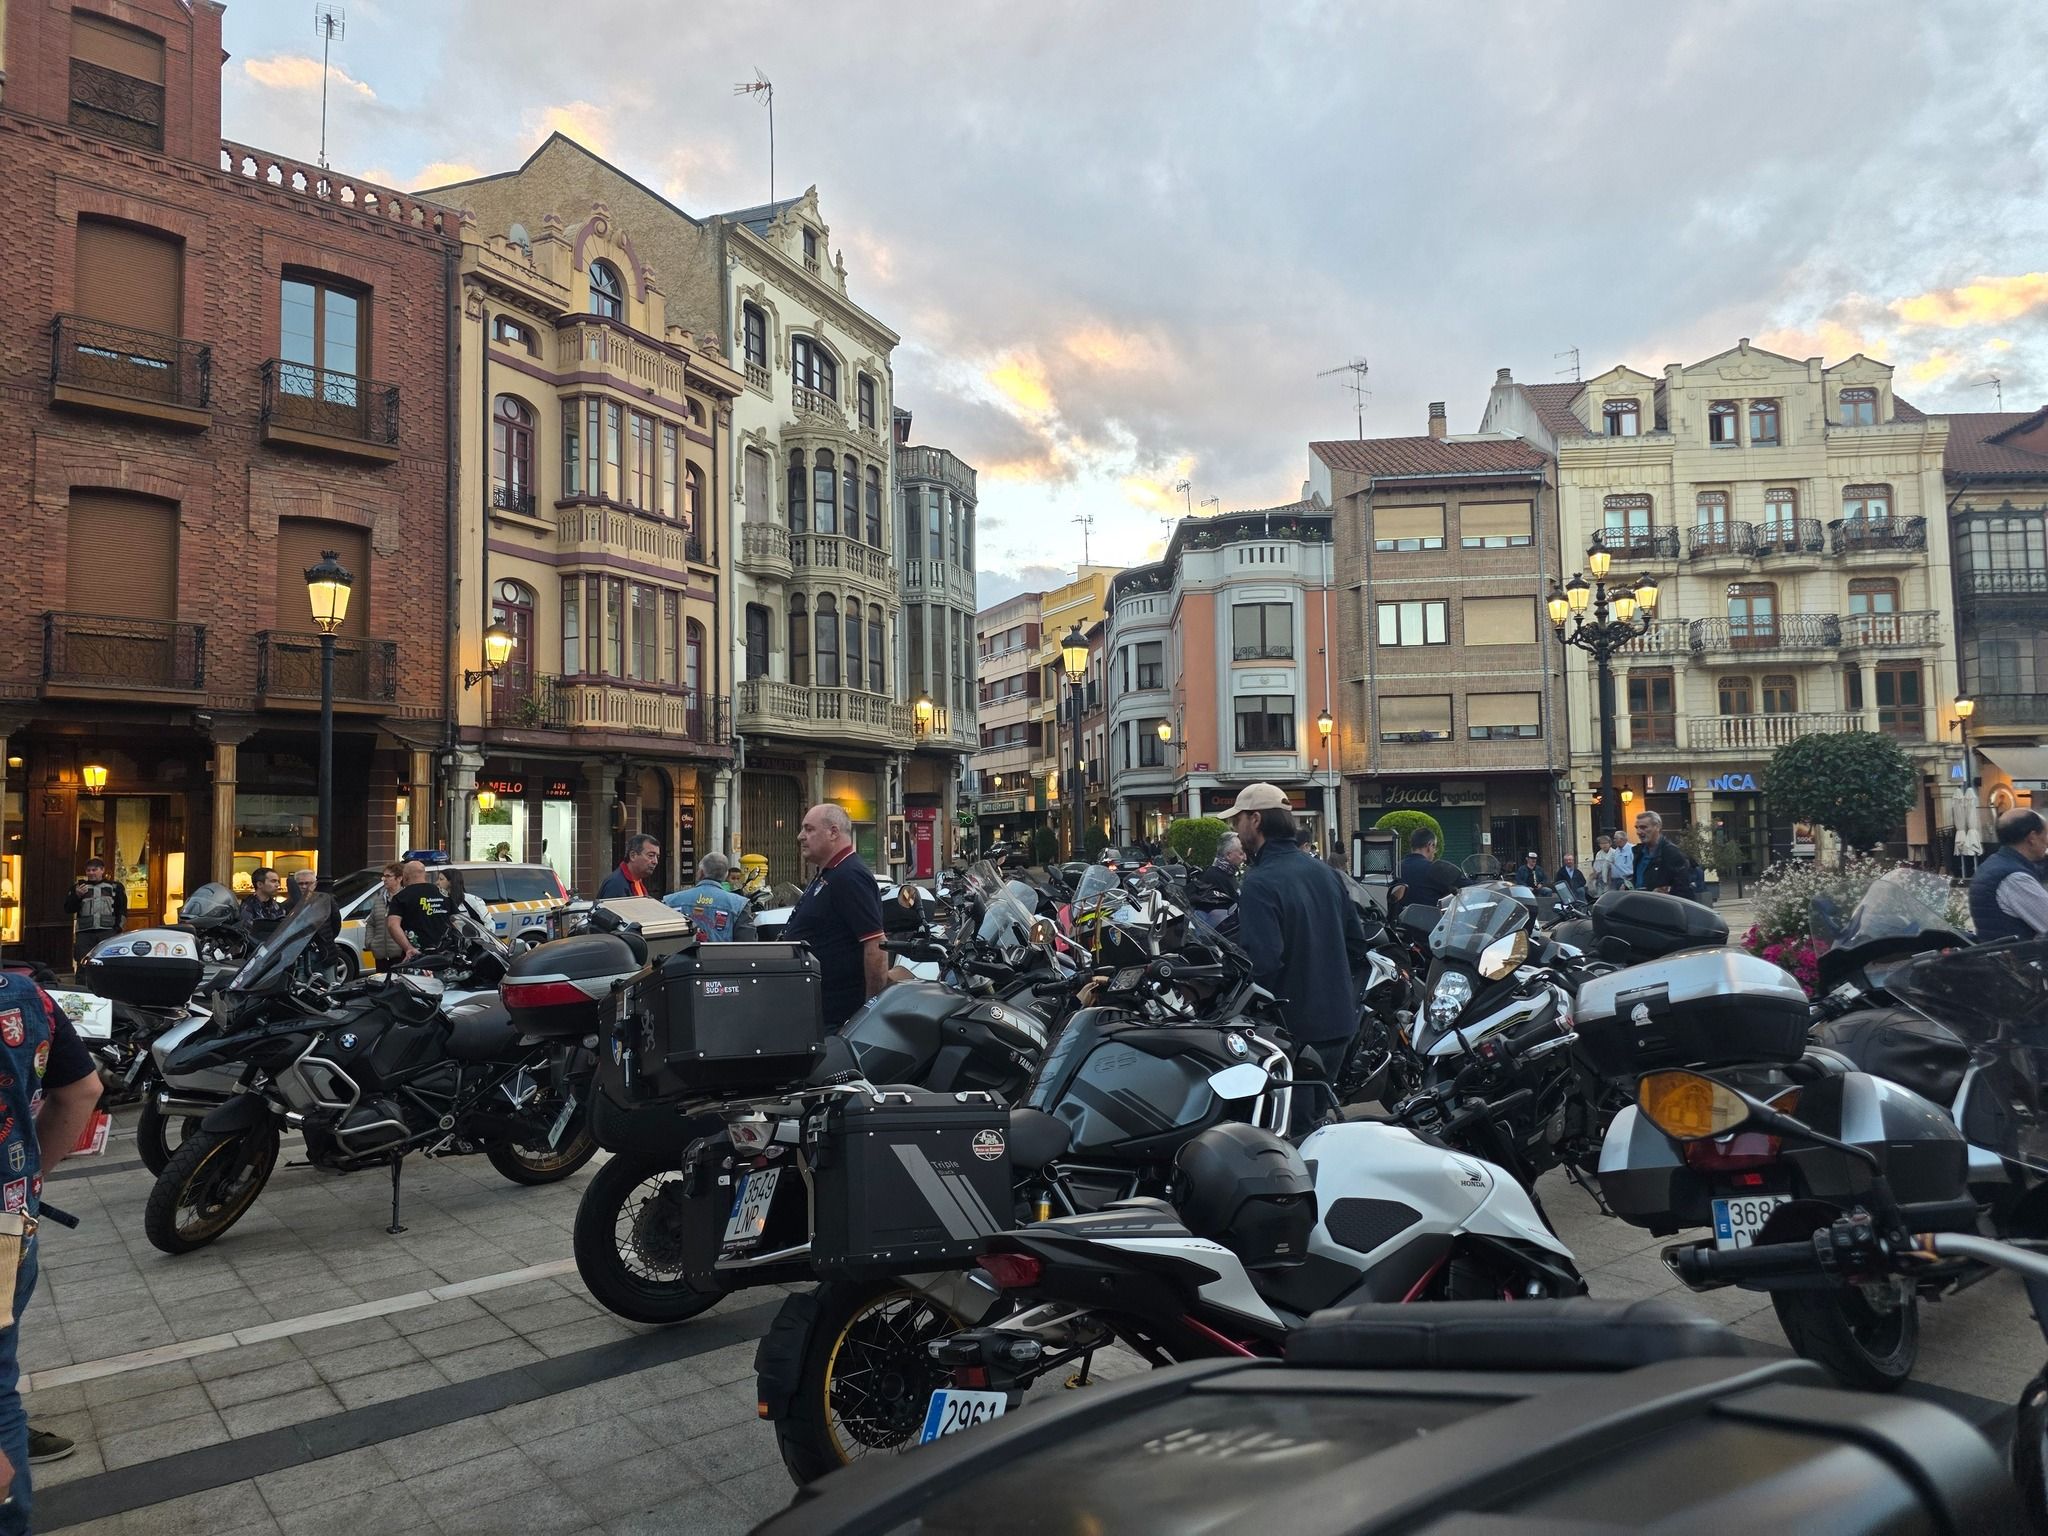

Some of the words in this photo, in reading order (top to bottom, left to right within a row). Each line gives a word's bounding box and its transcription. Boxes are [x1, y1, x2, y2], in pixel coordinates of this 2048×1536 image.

[1385, 785, 1439, 804] Isaac
[1441, 790, 1485, 805] regalos
[911, 809, 924, 819] GAES
[930, 1160, 960, 1169] Triple
[744, 1172, 776, 1205] 3549
[1460, 1180, 1486, 1188] HONDA
[734, 1204, 760, 1235] LNP
[1730, 1197, 1784, 1227] 368
[940, 1399, 997, 1438] 2961
